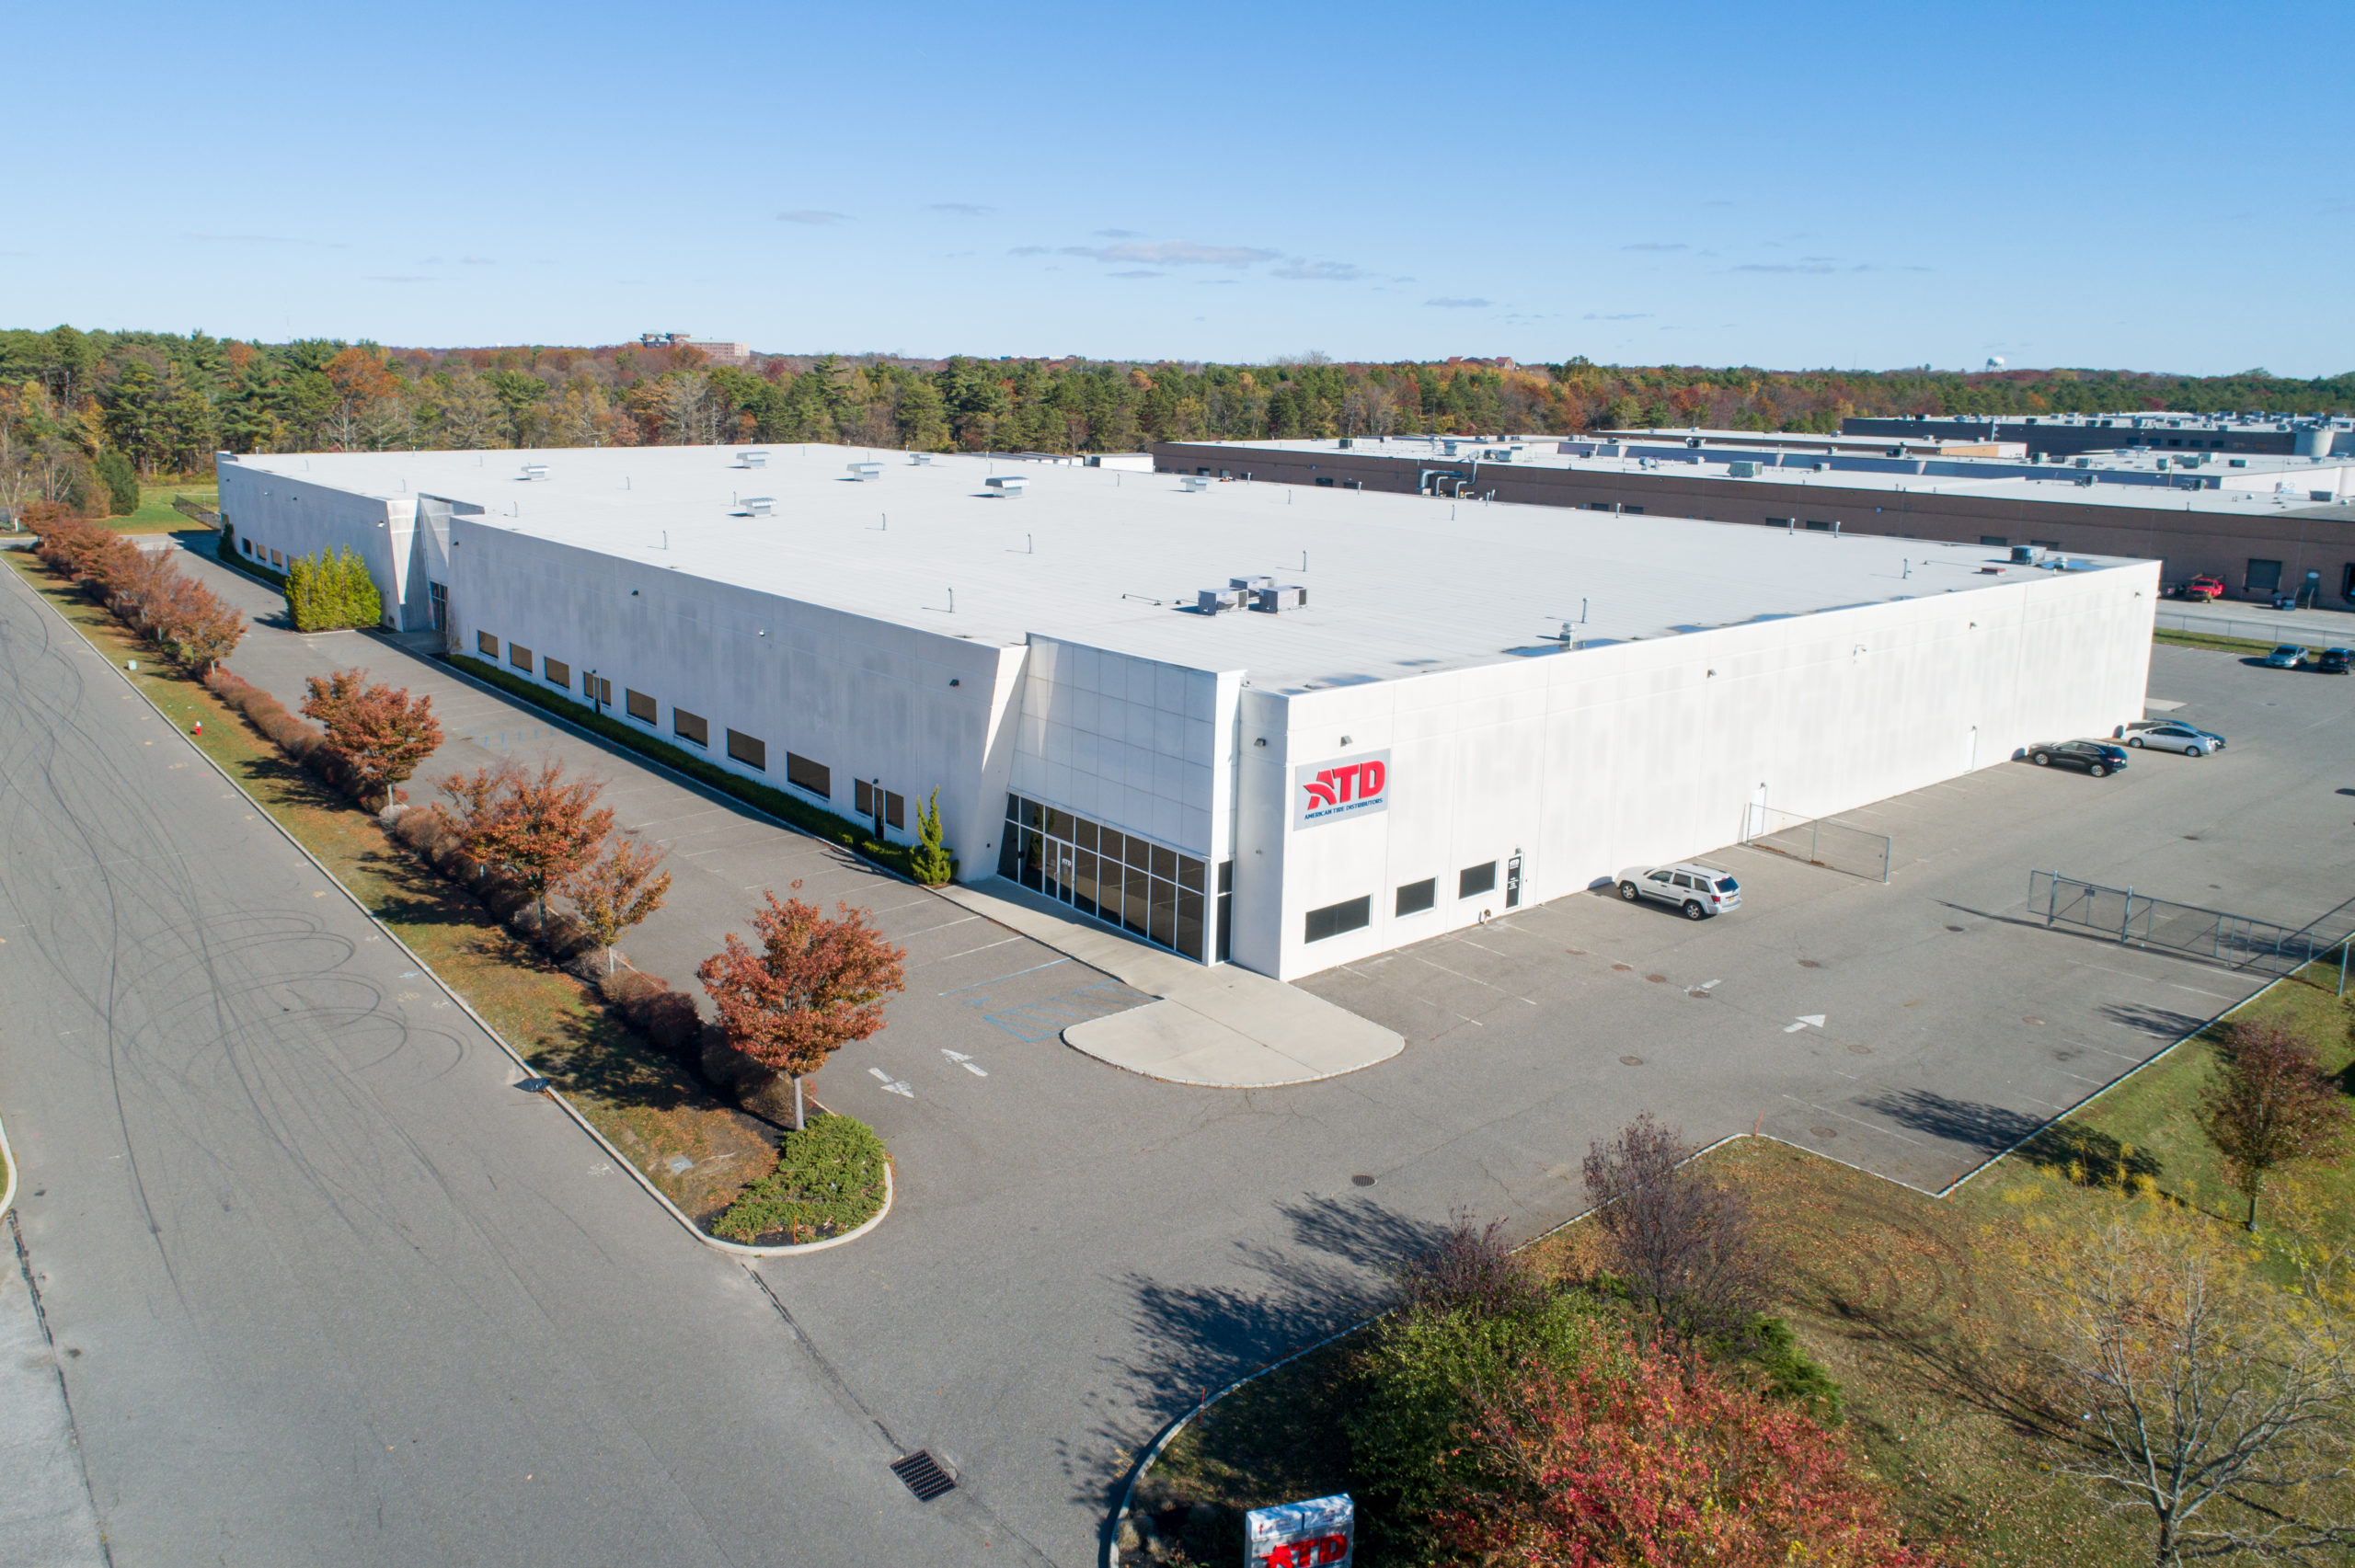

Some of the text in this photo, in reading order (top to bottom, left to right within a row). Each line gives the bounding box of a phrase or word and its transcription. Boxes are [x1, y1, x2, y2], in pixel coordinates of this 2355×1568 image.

[1303, 760, 1385, 810] ATD
[1304, 797, 1384, 820] AMERICAN TIRE DISTRIBUTORS
[1258, 1533, 1349, 1568] ATD
